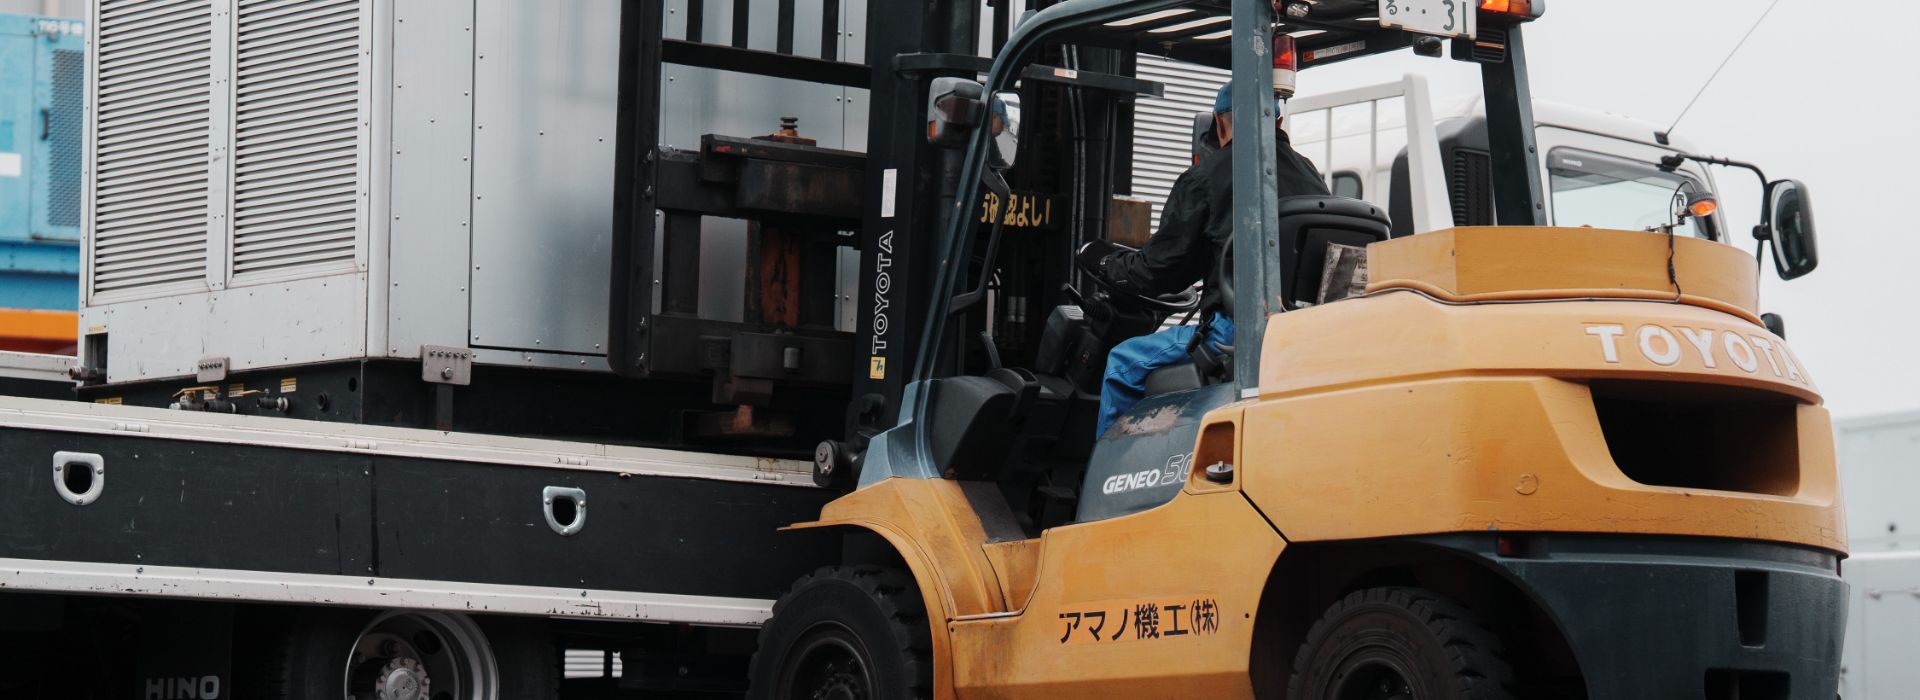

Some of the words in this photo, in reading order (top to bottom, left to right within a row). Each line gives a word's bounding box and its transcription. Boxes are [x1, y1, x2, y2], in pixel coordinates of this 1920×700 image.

[872, 230, 893, 354] TOYOTA
[1584, 323, 1808, 385] TOYOTA
[1102, 468, 1160, 495] GENEO
[146, 675, 220, 700] HINO
